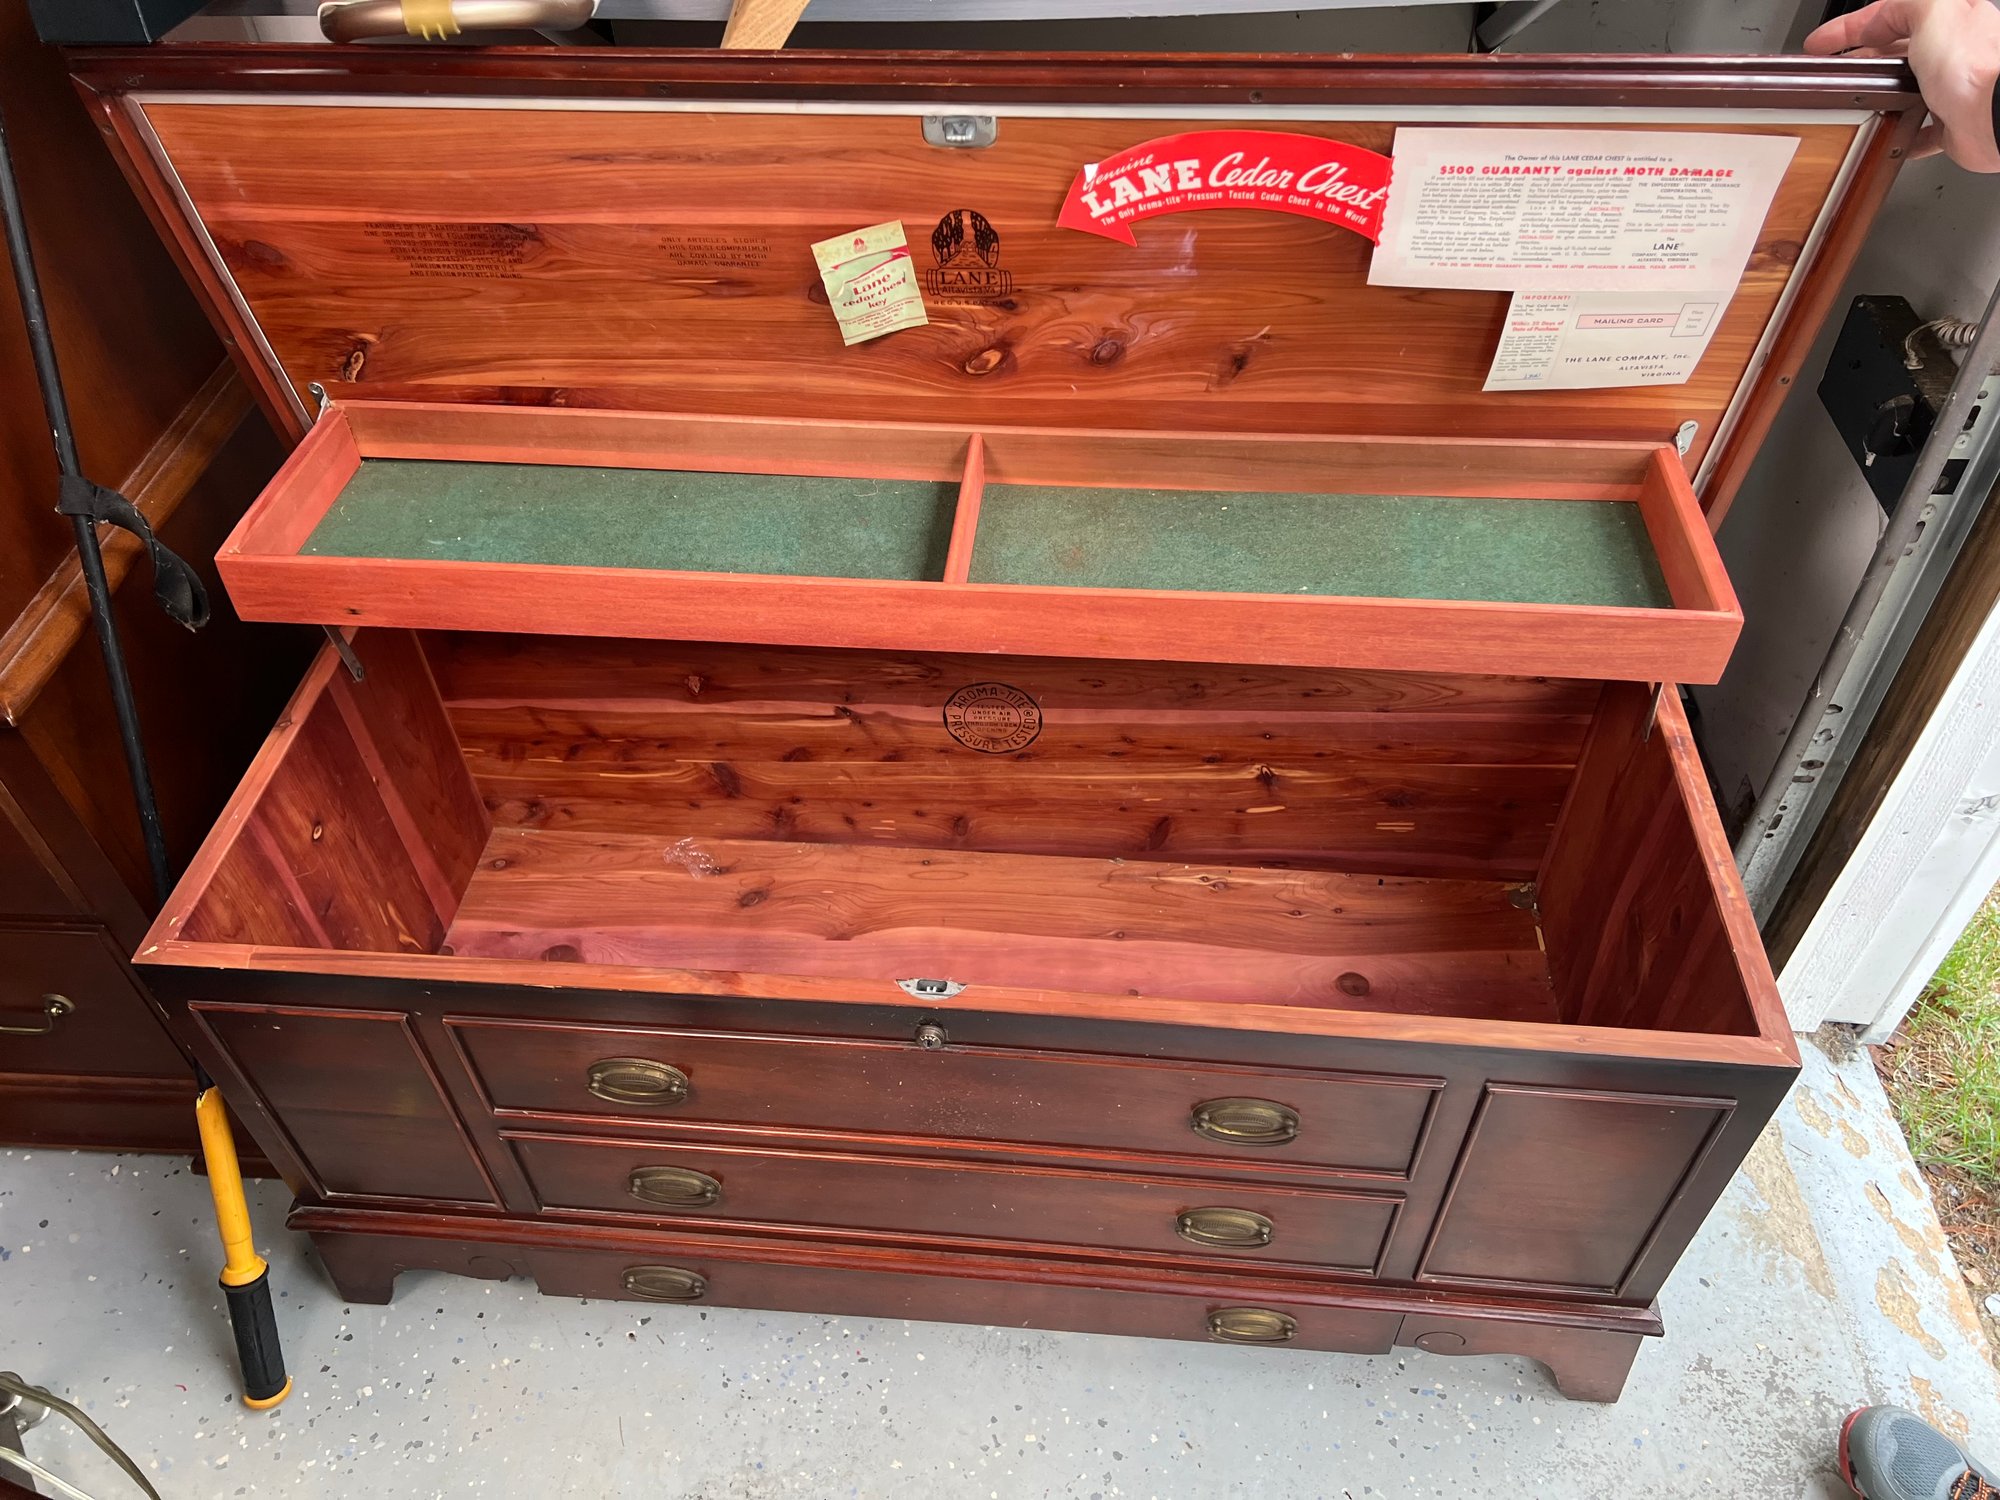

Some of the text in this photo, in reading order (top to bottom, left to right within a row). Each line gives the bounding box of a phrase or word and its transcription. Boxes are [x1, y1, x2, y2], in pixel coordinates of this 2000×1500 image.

[1082, 154, 1154, 192] Genuine
[1440, 165, 1734, 177] $500 GUARANTY against MOTH DAMAGE
[1080, 151, 1387, 219] LANE Cedar Chest
[1101, 216, 1115, 226] The
[1118, 207, 1135, 219] Only
[1187, 191, 1223, 201] Pressure
[1229, 190, 1255, 199] Tested
[1261, 191, 1282, 202] Cedar
[1288, 195, 1309, 206] Chest
[1315, 200, 1323, 209] in
[1327, 203, 1340, 214] the
[1345, 210, 1368, 225] World
[1653, 243, 1680, 251] LANE
[853, 274, 890, 295] Lane
[940, 271, 999, 285] LANE
[842, 277, 906, 307] cedar chest
[868, 298, 887, 308] key
[949, 714, 1036, 750] PRESSURE TESTED
